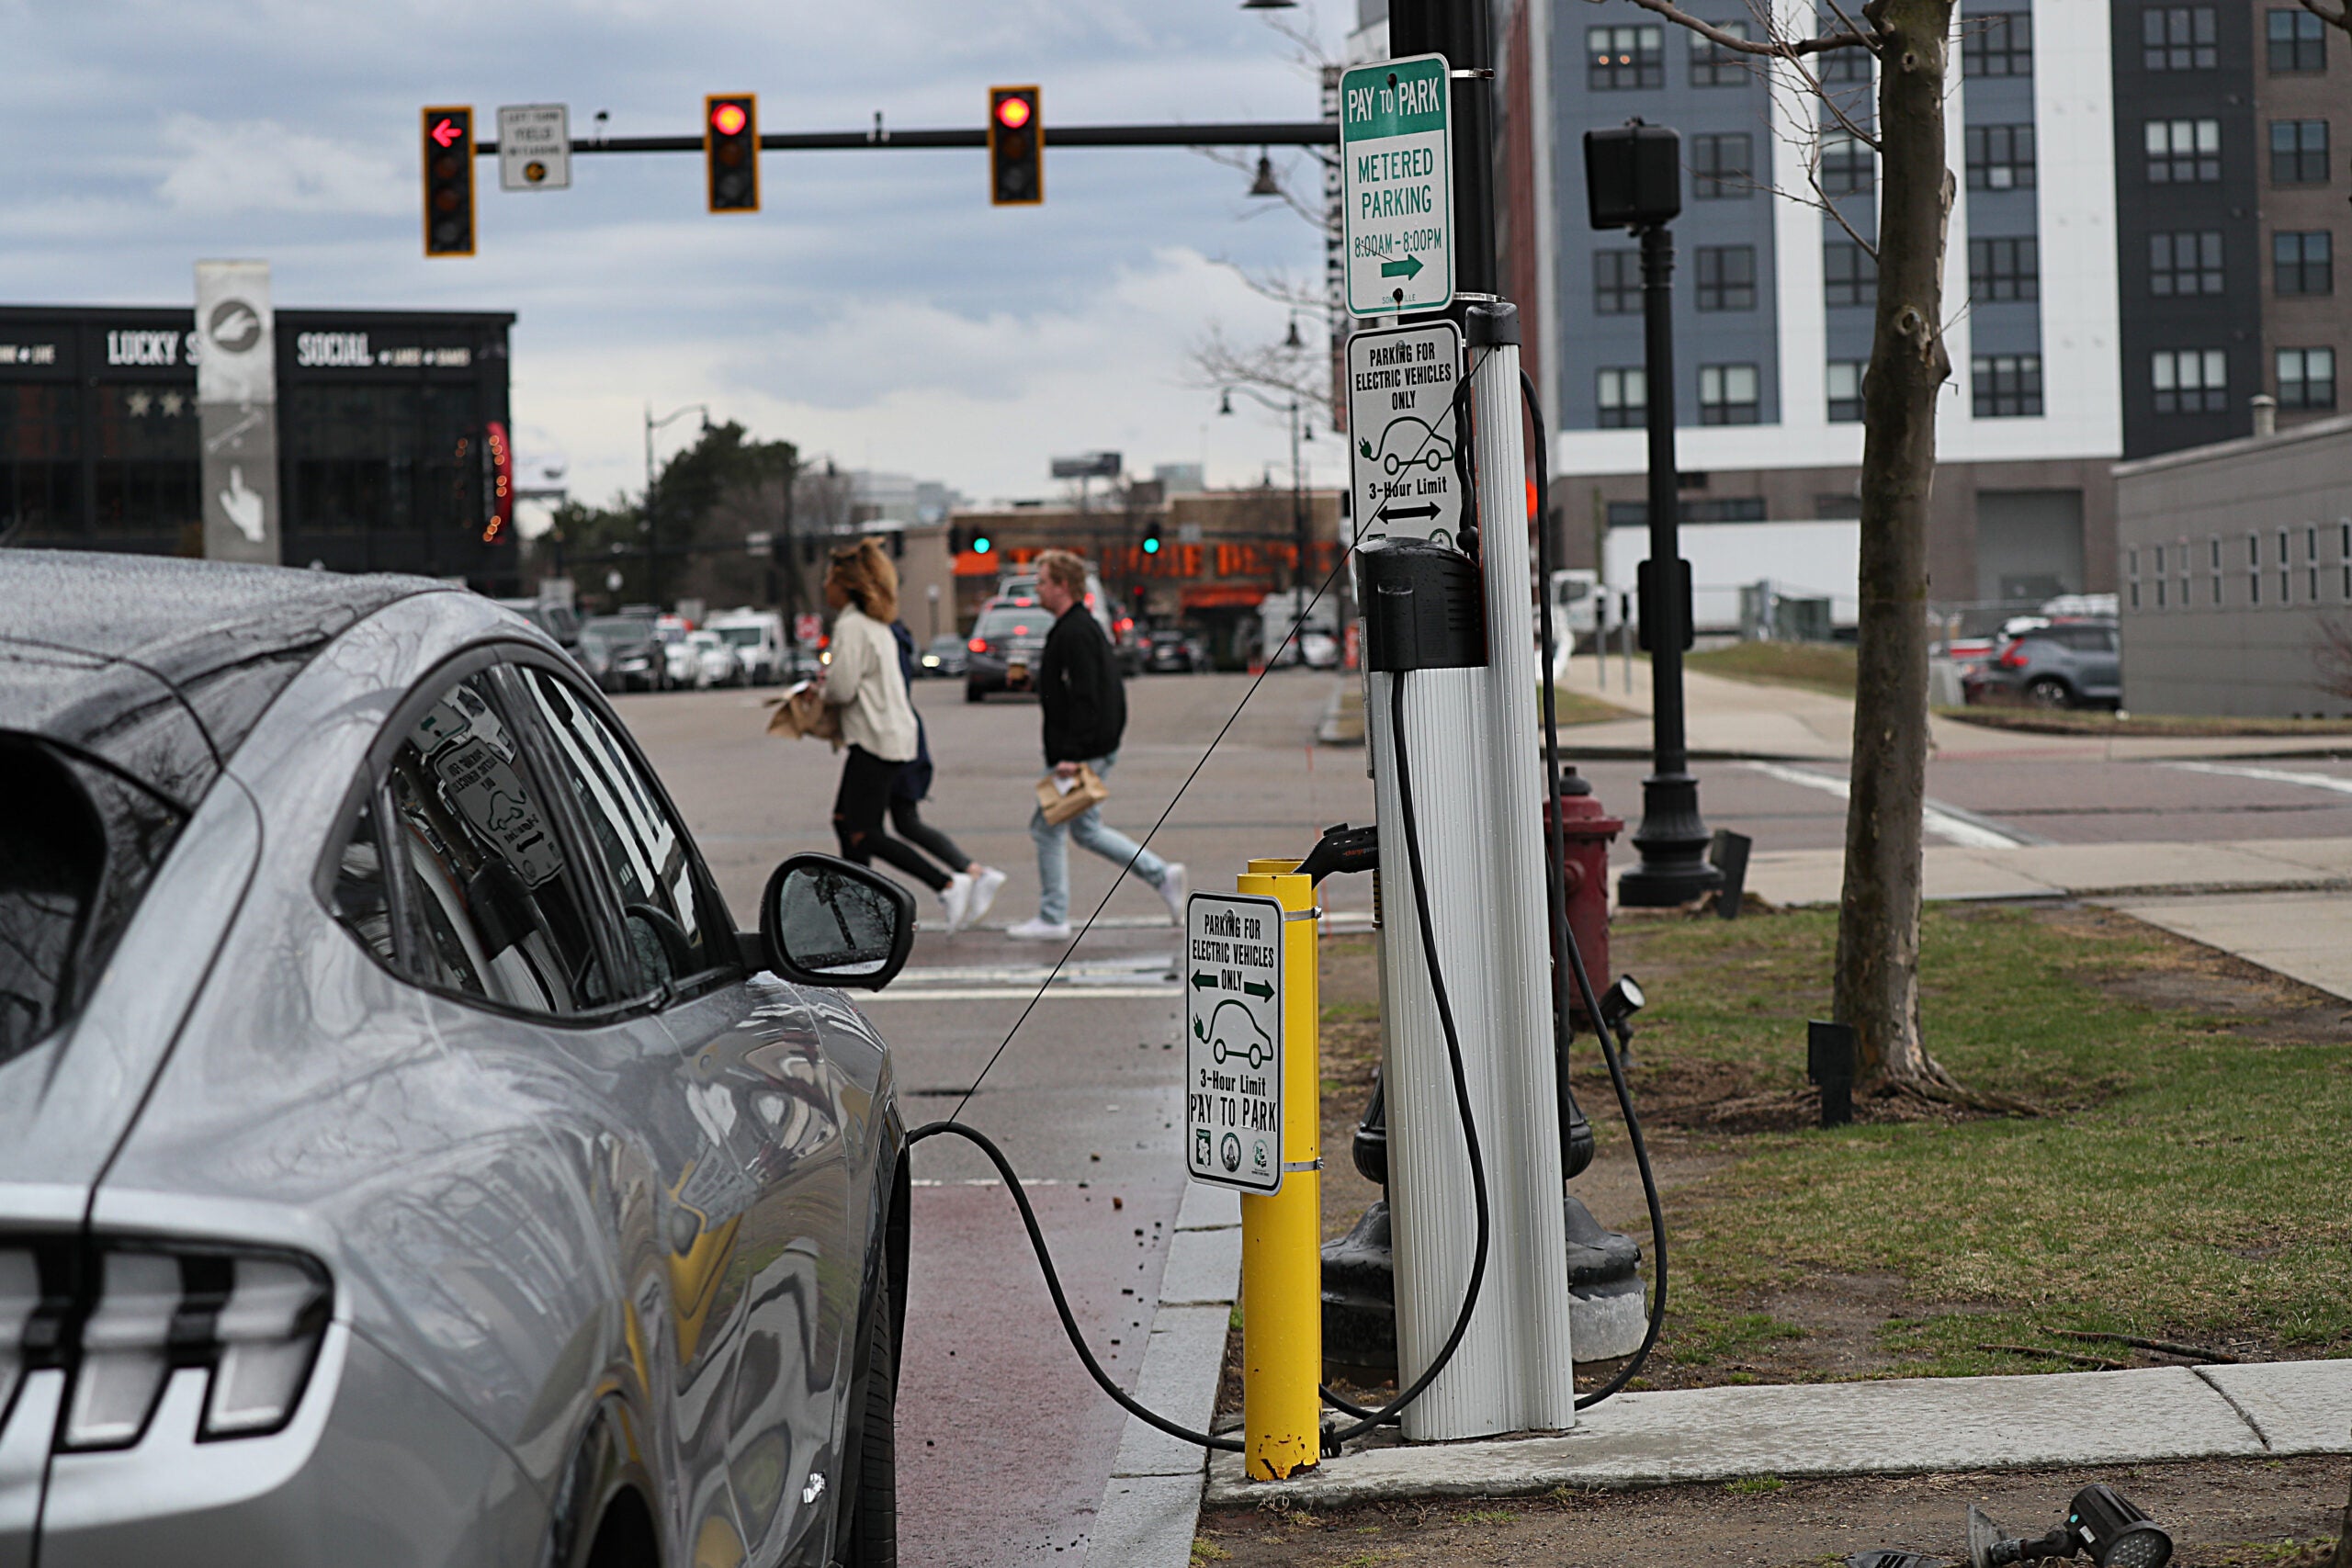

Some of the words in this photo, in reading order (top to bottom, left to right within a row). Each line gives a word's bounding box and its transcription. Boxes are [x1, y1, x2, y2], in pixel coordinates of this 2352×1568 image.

[1348, 86, 1374, 123] PAY
[1379, 89, 1394, 114] TO
[1398, 77, 1440, 116] PARK
[1358, 148, 1433, 184] METERED
[1362, 185, 1431, 220] PARKING
[107, 331, 179, 366] LUCKY
[298, 333, 374, 367] SOCIAL
[1370, 344, 1413, 367] PARKING
[1416, 342, 1435, 362] FOR
[1355, 369, 1401, 391] ELECTRIC
[1405, 363, 1452, 386] VEHICLES
[1391, 390, 1416, 411] ONLY
[1369, 481, 1411, 500] 3-Hour
[1417, 476, 1447, 495] Limit
[1204, 914, 1240, 938] PARKING
[1244, 918, 1261, 940] FOR
[1193, 940, 1229, 964] ELECTRIC
[1233, 943, 1274, 968] VEHICLES
[1221, 969, 1243, 991] ONLY
[1200, 1068, 1236, 1092] 3-Hour
[1240, 1074, 1266, 1097] Limit
[1190, 1093, 1213, 1123] PAY
[1220, 1097, 1236, 1127] TO
[1243, 1098, 1277, 1132] PARK
